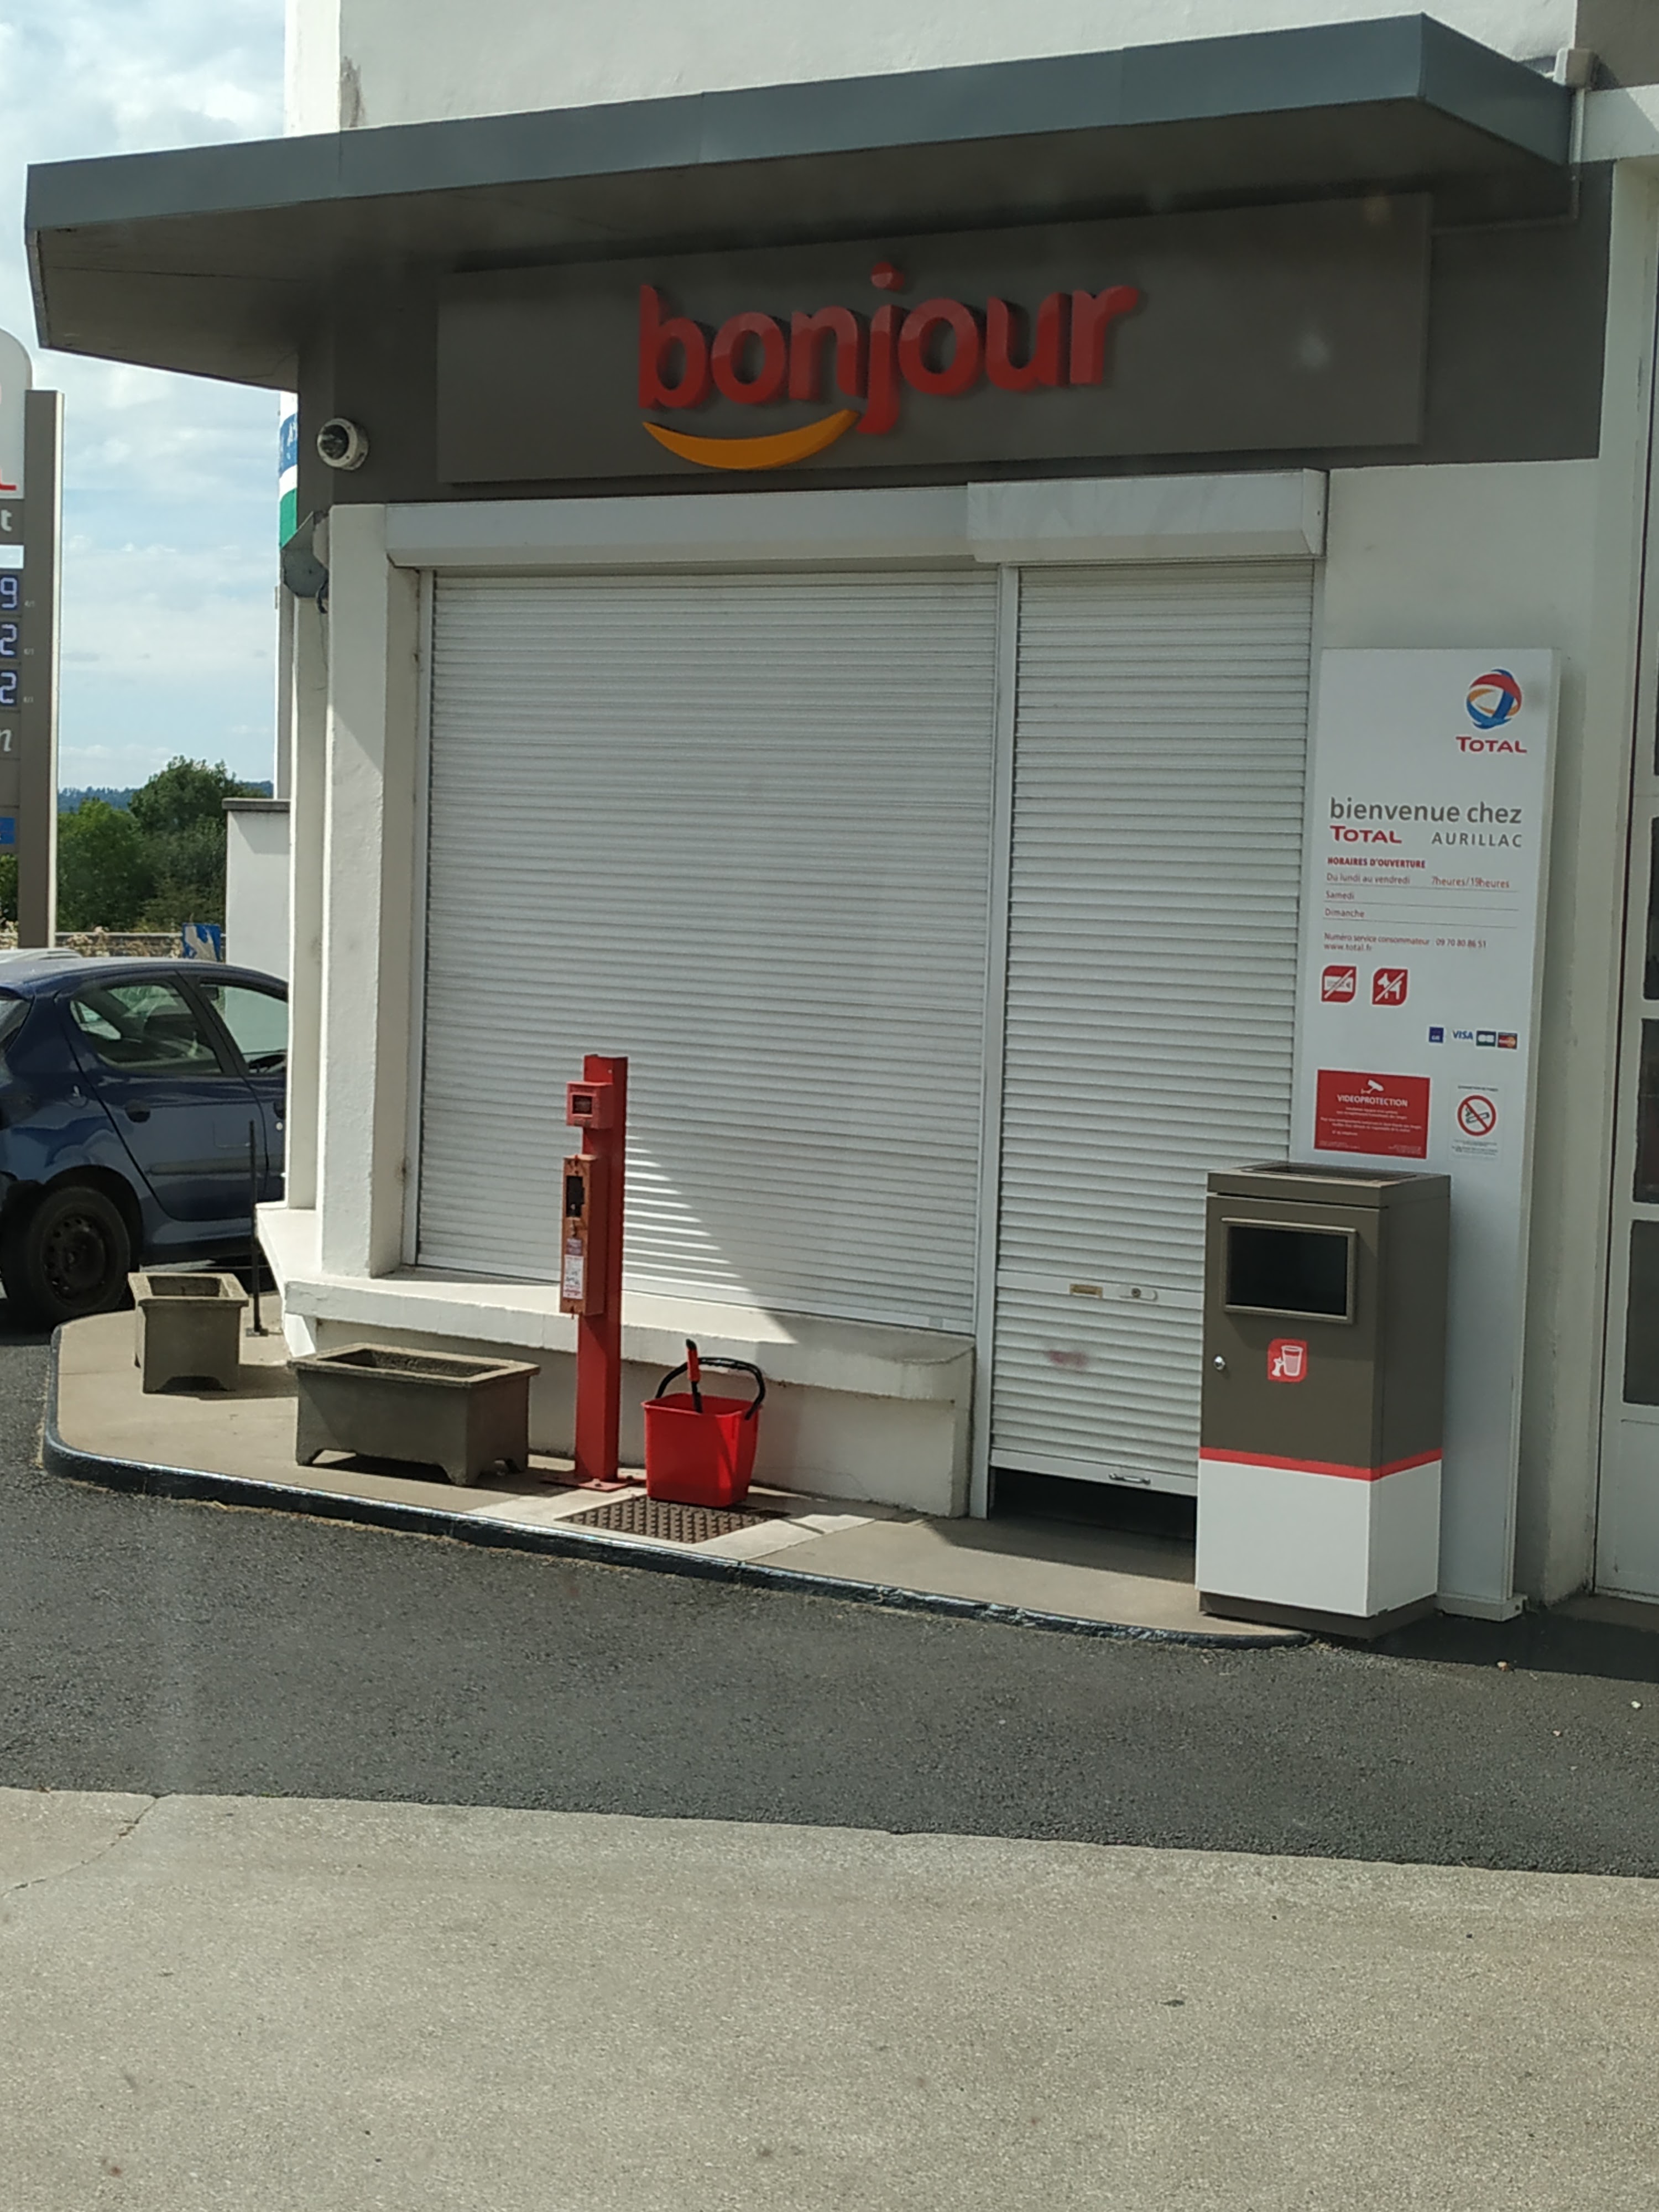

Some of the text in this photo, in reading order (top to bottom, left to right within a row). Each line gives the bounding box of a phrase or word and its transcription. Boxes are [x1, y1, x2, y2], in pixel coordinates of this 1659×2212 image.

[639, 262, 1139, 435] bonjour
[1456, 736, 1527, 753] TOTAL
[1330, 797, 1522, 824] bienvenue chez
[1329, 825, 1522, 848] TOTAL AURILLAC
[1327, 857, 1426, 869] HORAIRES D'OUVERTURE
[1327, 873, 1338, 881] Du
[1340, 873, 1360, 883] lundi
[1375, 875, 1410, 884] vendredi
[1326, 890, 1354, 900] Samedi
[1325, 908, 1365, 918] Dimanche
[1453, 1030, 1474, 1040] VISA
[1337, 1094, 1408, 1107] VIDEOPROTECTION
